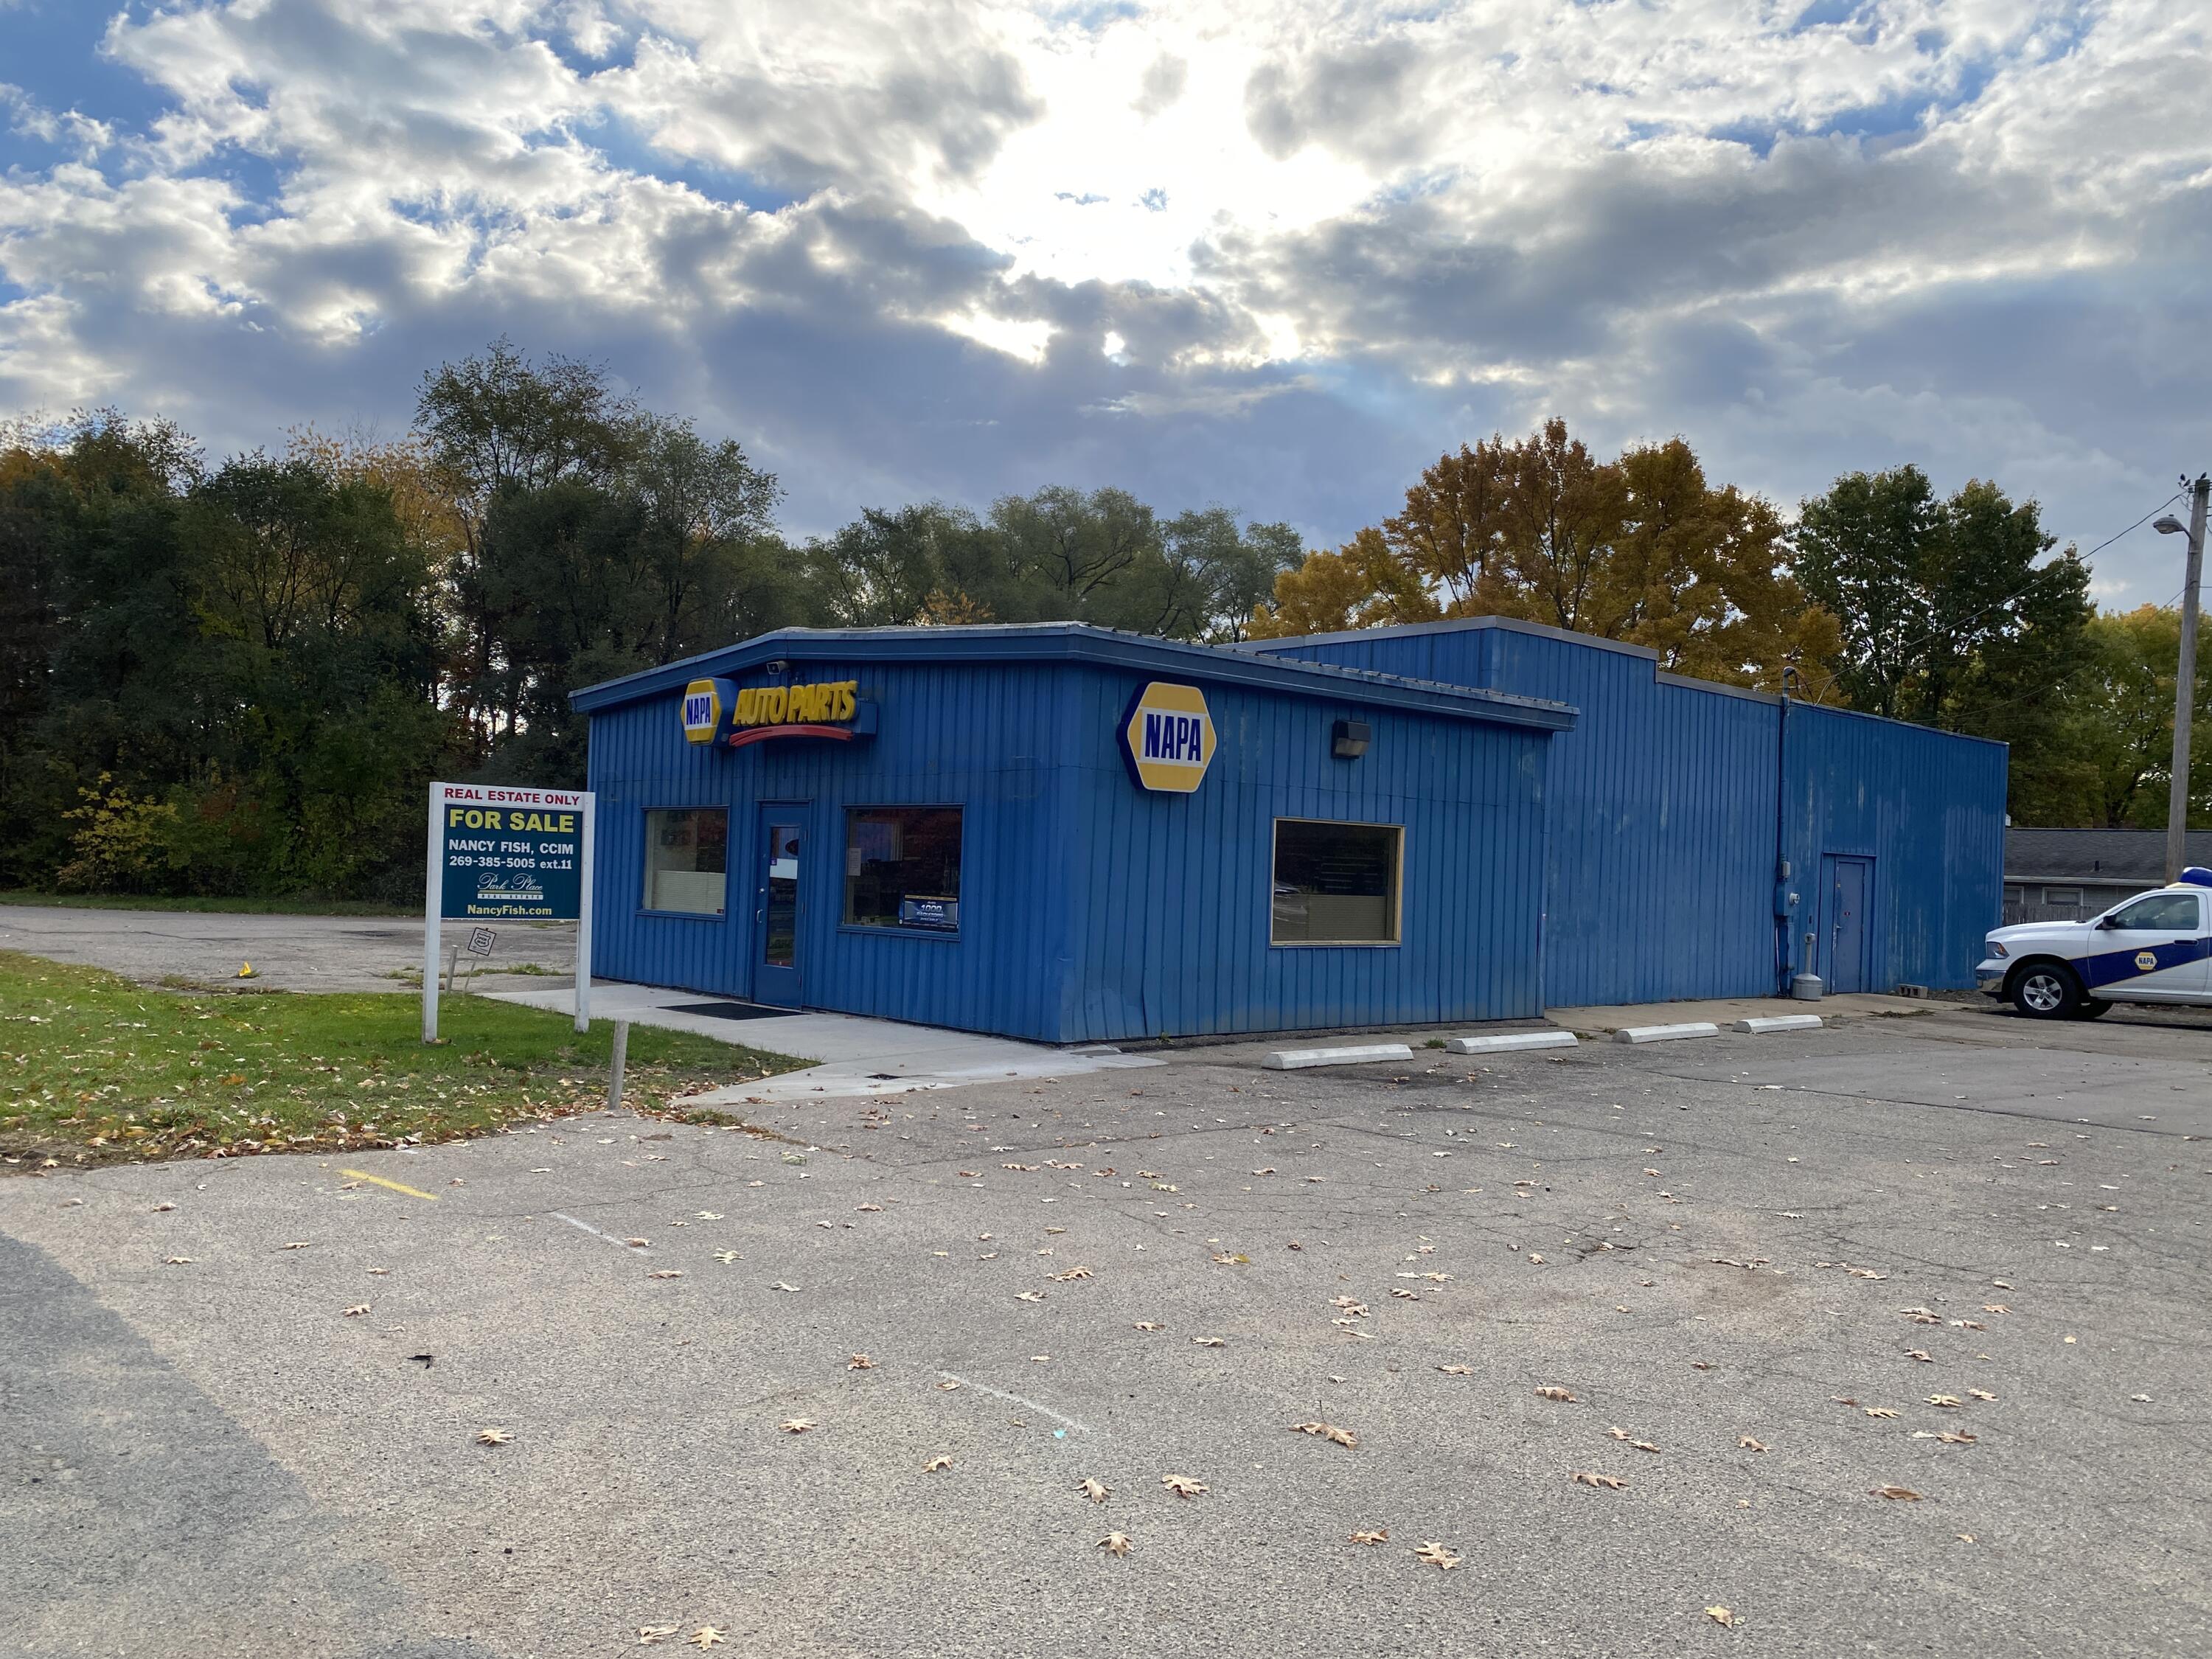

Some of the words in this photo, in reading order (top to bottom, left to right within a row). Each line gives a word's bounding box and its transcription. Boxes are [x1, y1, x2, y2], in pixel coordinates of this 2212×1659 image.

[686, 696, 711, 726] NAPA
[733, 686, 787, 725] AUTO
[787, 681, 857, 723] PARTS
[1144, 713, 1201, 762] NAPA
[444, 787, 483, 800] REAL
[487, 790, 540, 804] ESTATE
[544, 794, 580, 806] ONLY
[449, 808, 502, 830] FOR
[509, 812, 574, 833] SALE
[448, 838, 495, 852] NANCY
[500, 841, 535, 855] FISH,
[539, 843, 574, 855] CCIM
[448, 855, 536, 869] 269-385-5005
[539, 859, 573, 870] ext.11
[477, 872, 509, 890] Park
[511, 873, 543, 891] Place
[467, 905, 552, 917] NancyFish.com
[2138, 957, 2154, 965] NAPA
